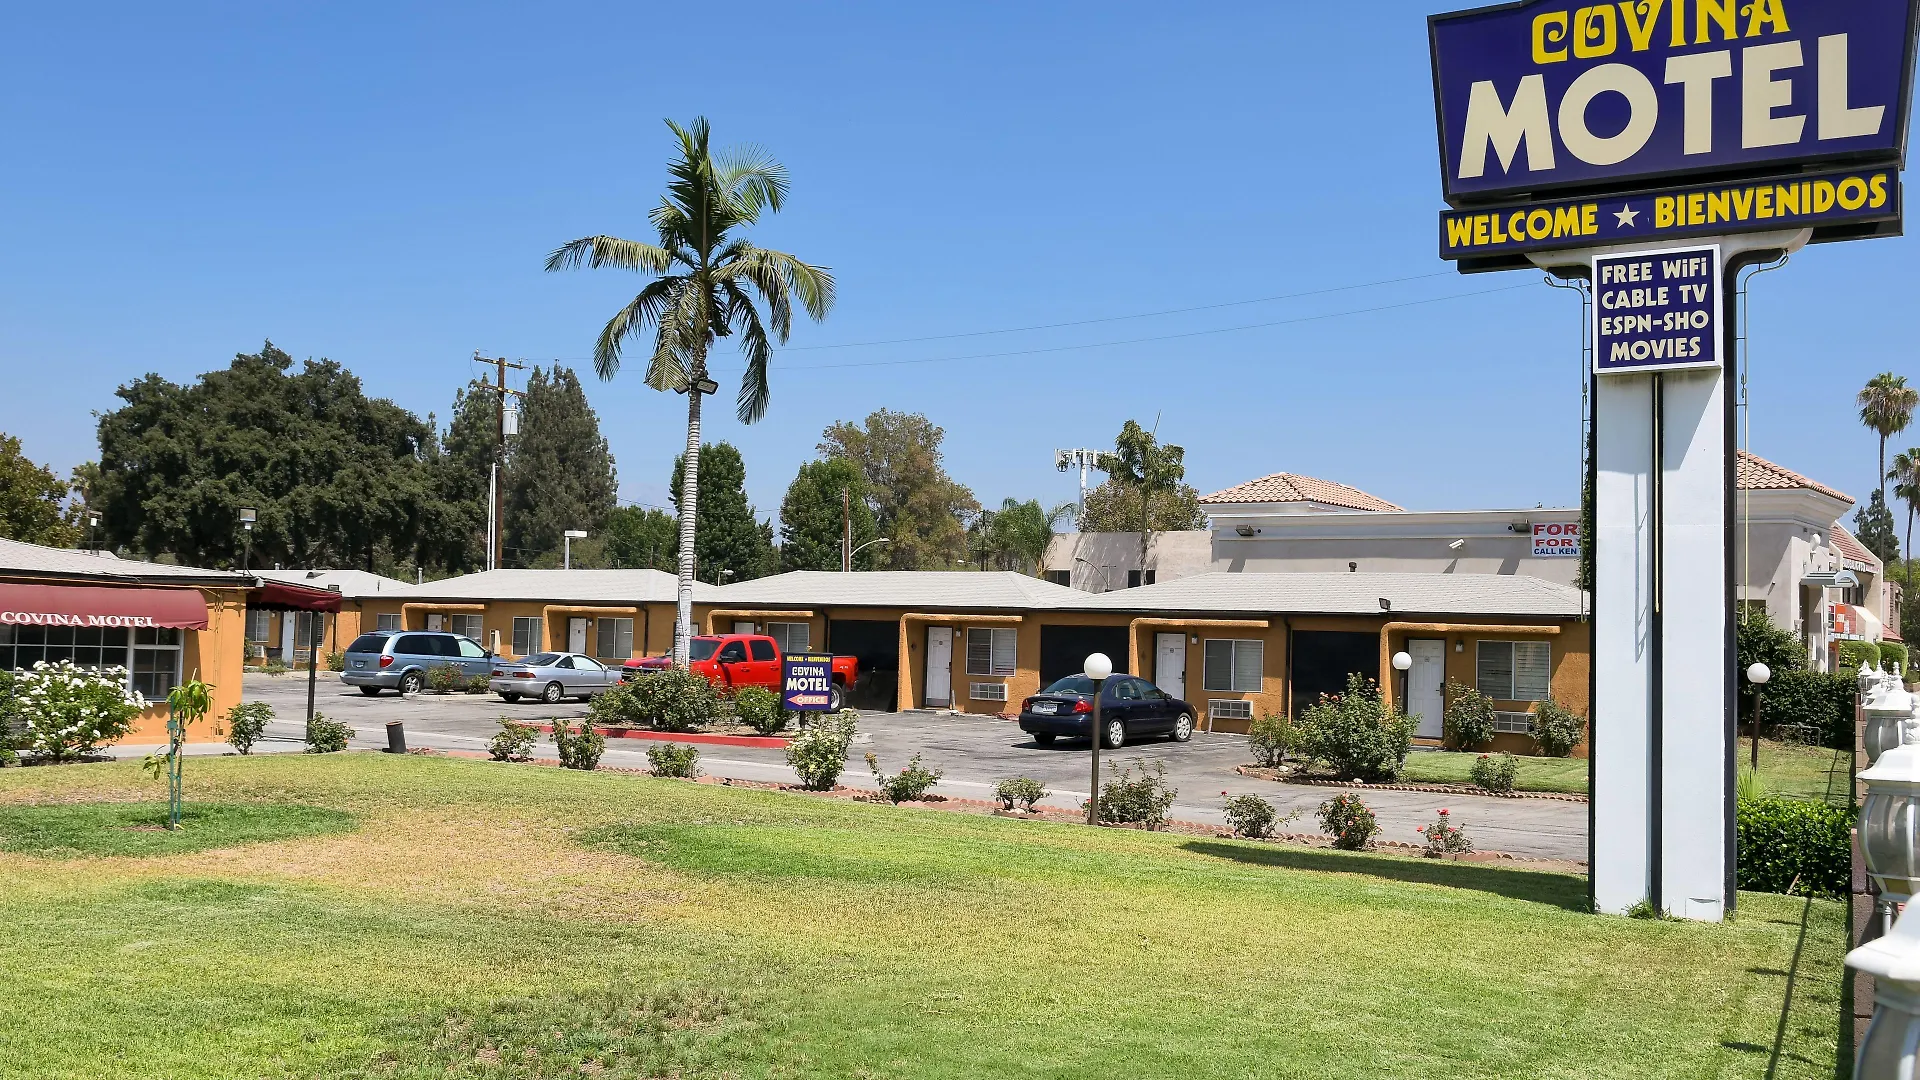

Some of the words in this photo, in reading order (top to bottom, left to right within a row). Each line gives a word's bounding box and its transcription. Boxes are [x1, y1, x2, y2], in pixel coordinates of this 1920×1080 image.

[1532, 0, 1791, 64] COVINA
[1457, 33, 1886, 179] MOTEL
[1446, 204, 1599, 247] WELCOME
[1655, 174, 1887, 229] BIENVENIDOS
[1602, 261, 1653, 284] FREE
[1662, 257, 1707, 280] WiFi
[1602, 286, 1669, 310] CABLE
[1679, 283, 1708, 305] TV
[1601, 310, 1709, 336] ESPN-SHO
[1610, 337, 1701, 362] MOVIES
[1533, 524, 1578, 536] FOR
[0, 612, 84, 625] COVINA
[87, 614, 160, 627] MOTEL
[792, 666, 824, 676] COVINA
[786, 678, 829, 691] MOTEL
